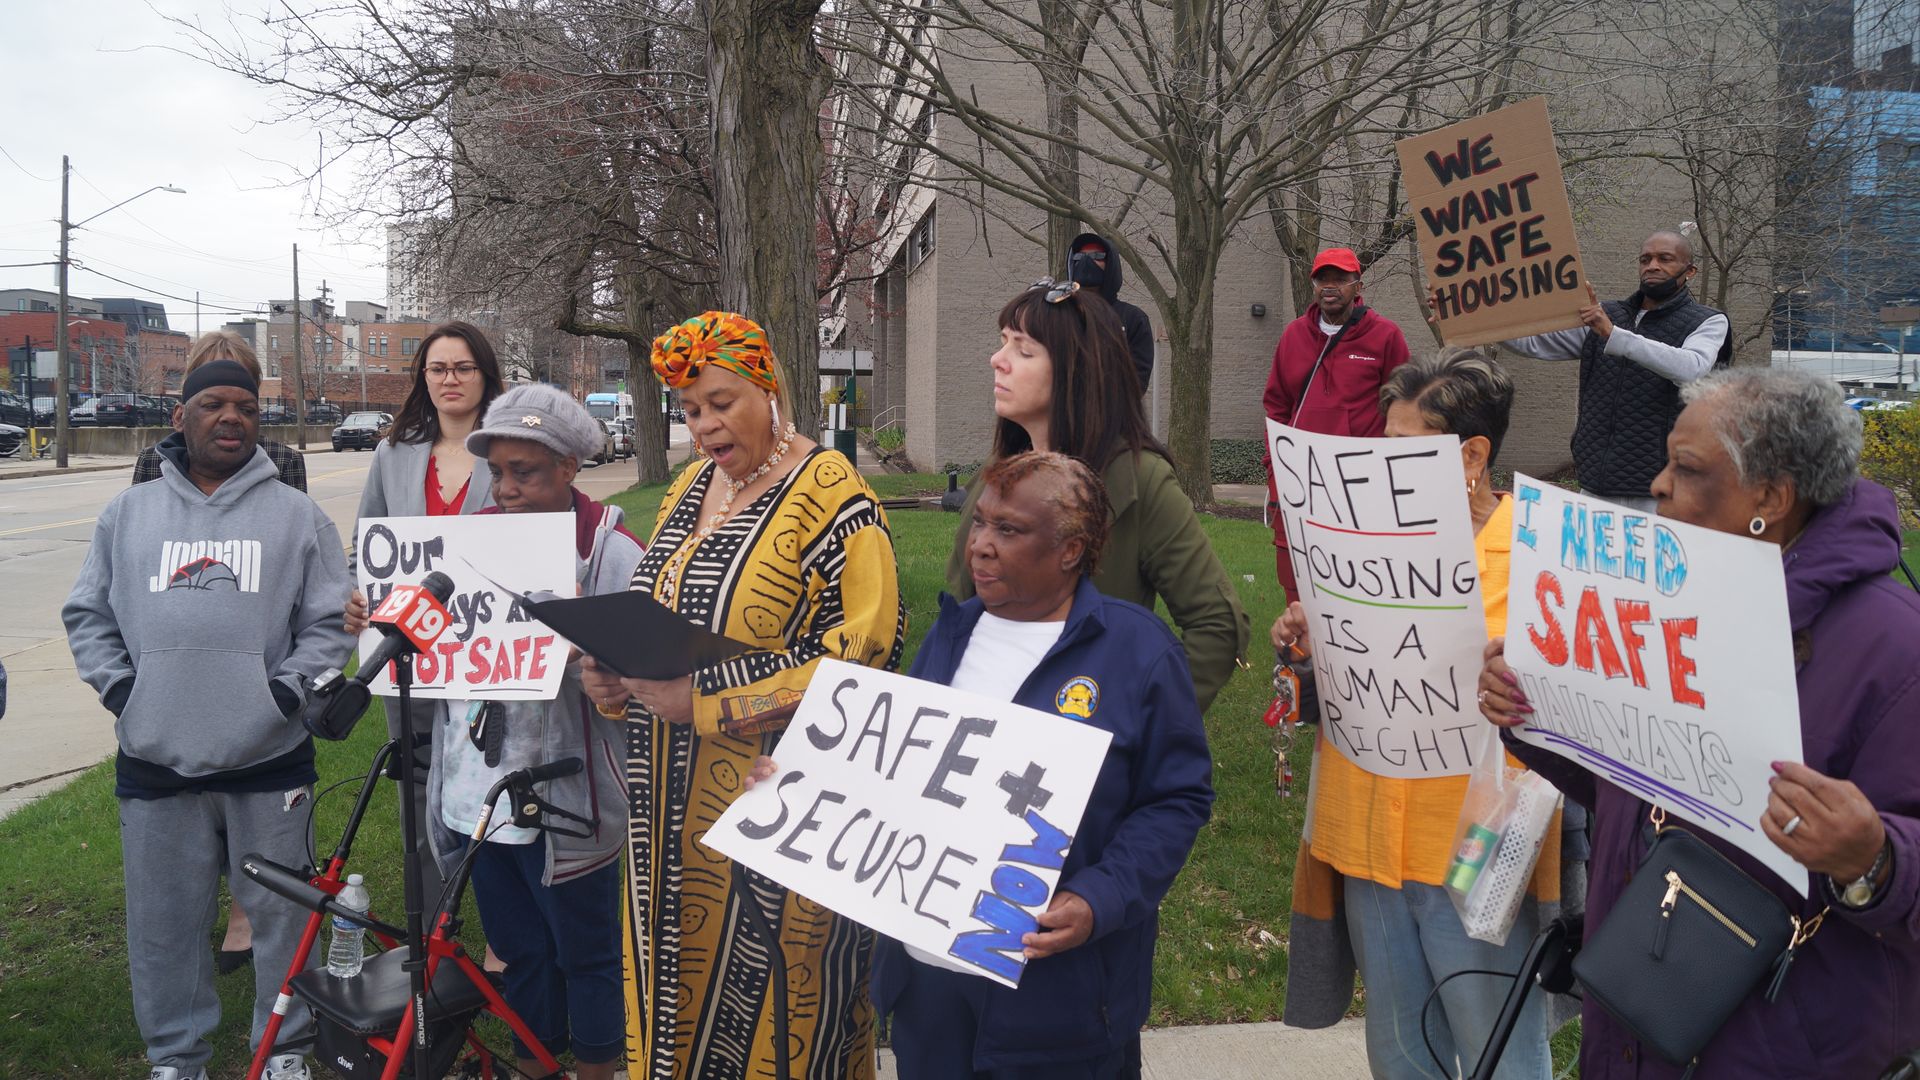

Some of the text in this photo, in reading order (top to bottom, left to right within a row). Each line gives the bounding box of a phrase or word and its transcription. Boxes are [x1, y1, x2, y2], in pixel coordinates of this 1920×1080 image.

[1424, 133, 1502, 187] WE
[1420, 172, 1540, 237] WANT
[1434, 214, 1552, 277] SAFE
[1435, 254, 1578, 321] HOUSING
[1275, 435, 1439, 530] SAFE
[1282, 510, 1476, 599] HOUSING
[1517, 483, 1689, 598] I NEED
[377, 590, 415, 617] 19
[404, 597, 445, 640] 19
[1320, 613, 1427, 660] IS A
[1526, 569, 1706, 709] SAFE
[464, 635, 554, 685] SAFE
[1313, 637, 1461, 719] HUMAN
[805, 678, 998, 809] SAFE
[1325, 699, 1477, 772] RIGHT
[736, 770, 978, 930] SECURE
[948, 809, 1074, 985] NOW
